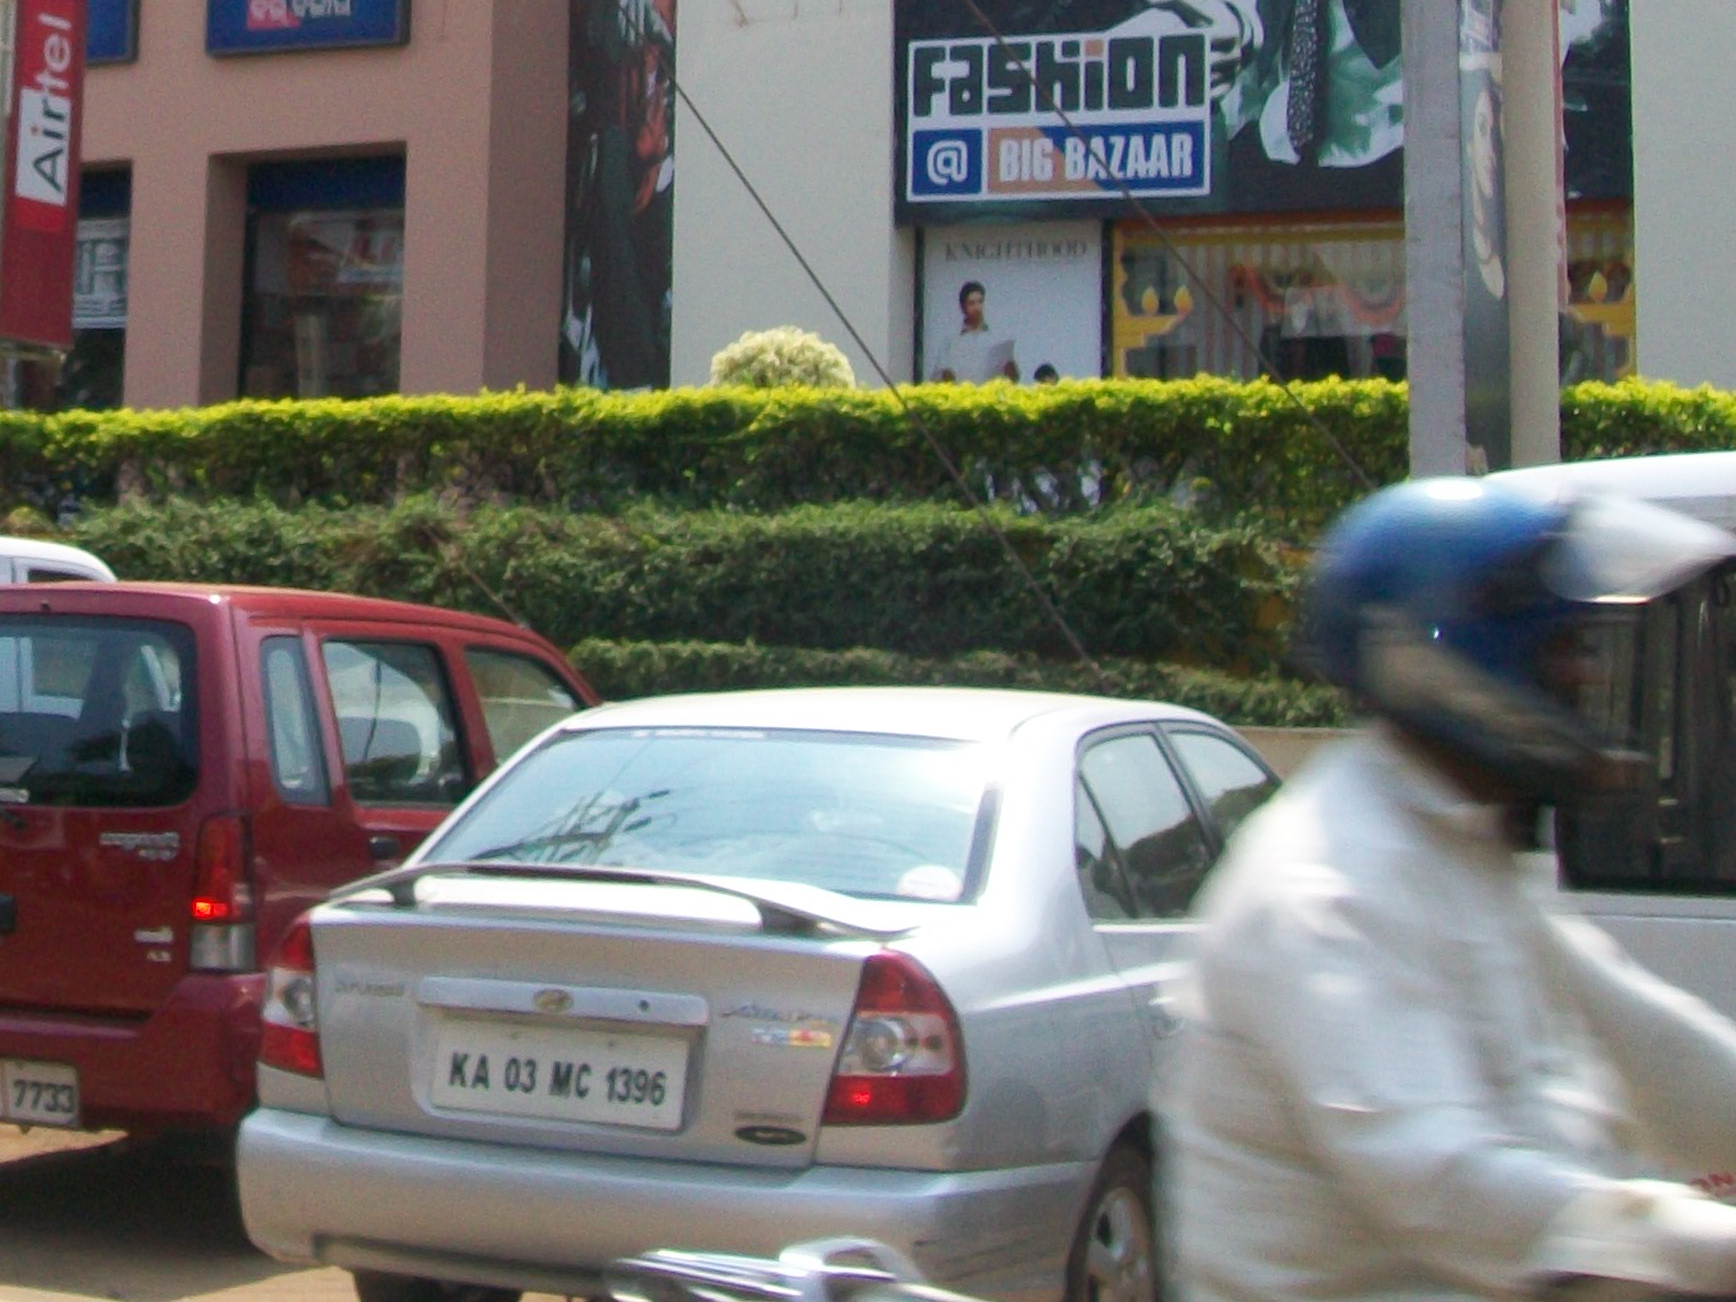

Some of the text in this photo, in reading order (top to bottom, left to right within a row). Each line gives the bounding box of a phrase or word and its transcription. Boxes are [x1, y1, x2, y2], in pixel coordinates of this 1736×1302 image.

[31, 11, 73, 195] Airtel
[925, 132, 1195, 186] @ BIG BAZAAR
[12, 1077, 77, 1115] 7733
[448, 1050, 668, 1107] KA 03 MC 1396
